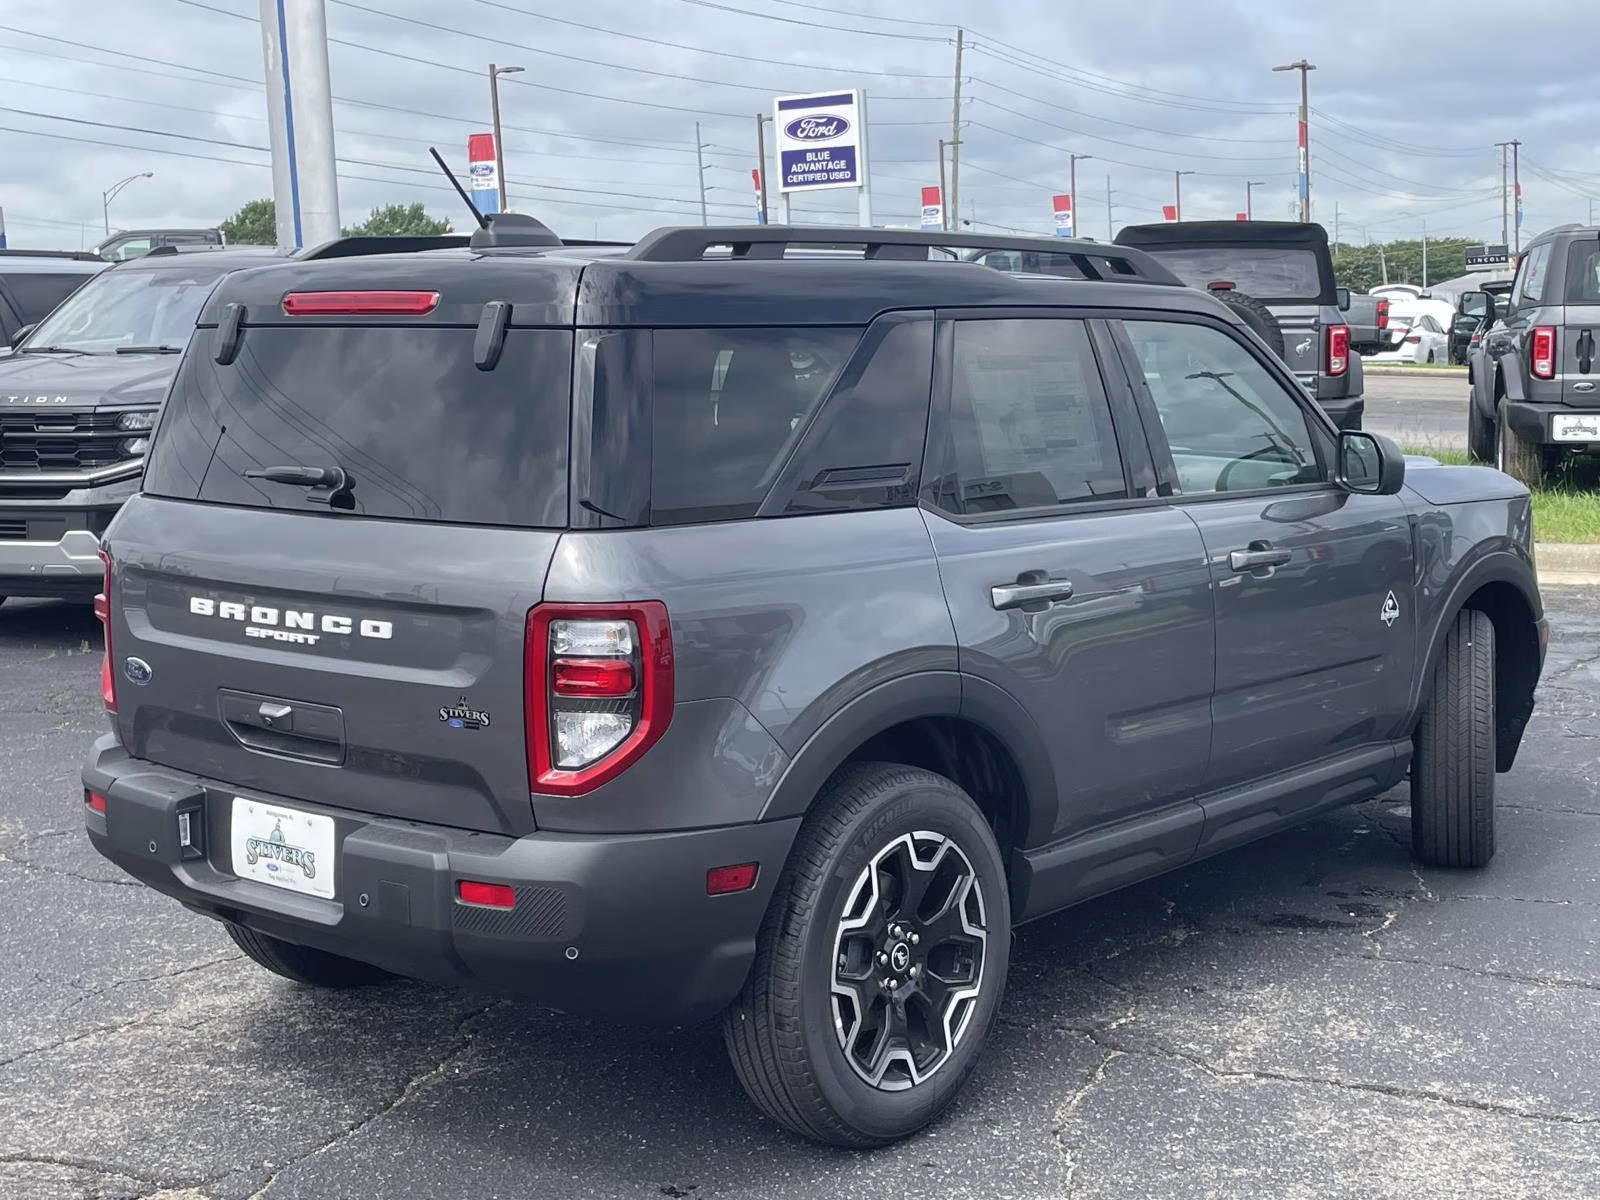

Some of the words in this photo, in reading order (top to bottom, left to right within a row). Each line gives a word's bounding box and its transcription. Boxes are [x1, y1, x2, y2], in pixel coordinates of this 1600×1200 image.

[797, 117, 838, 138] Ford
[806, 151, 830, 161] BLUE
[791, 160, 847, 172] ADVANTAGE
[787, 173, 828, 183] CERTIFIED
[829, 171, 851, 180] USED
[1467, 256, 1506, 264] LINCOLN
[190, 597, 393, 640] BRONCO
[245, 626, 320, 645] SPORT
[439, 707, 489, 726] STIVERS
[246, 838, 316, 880] STIVERS
